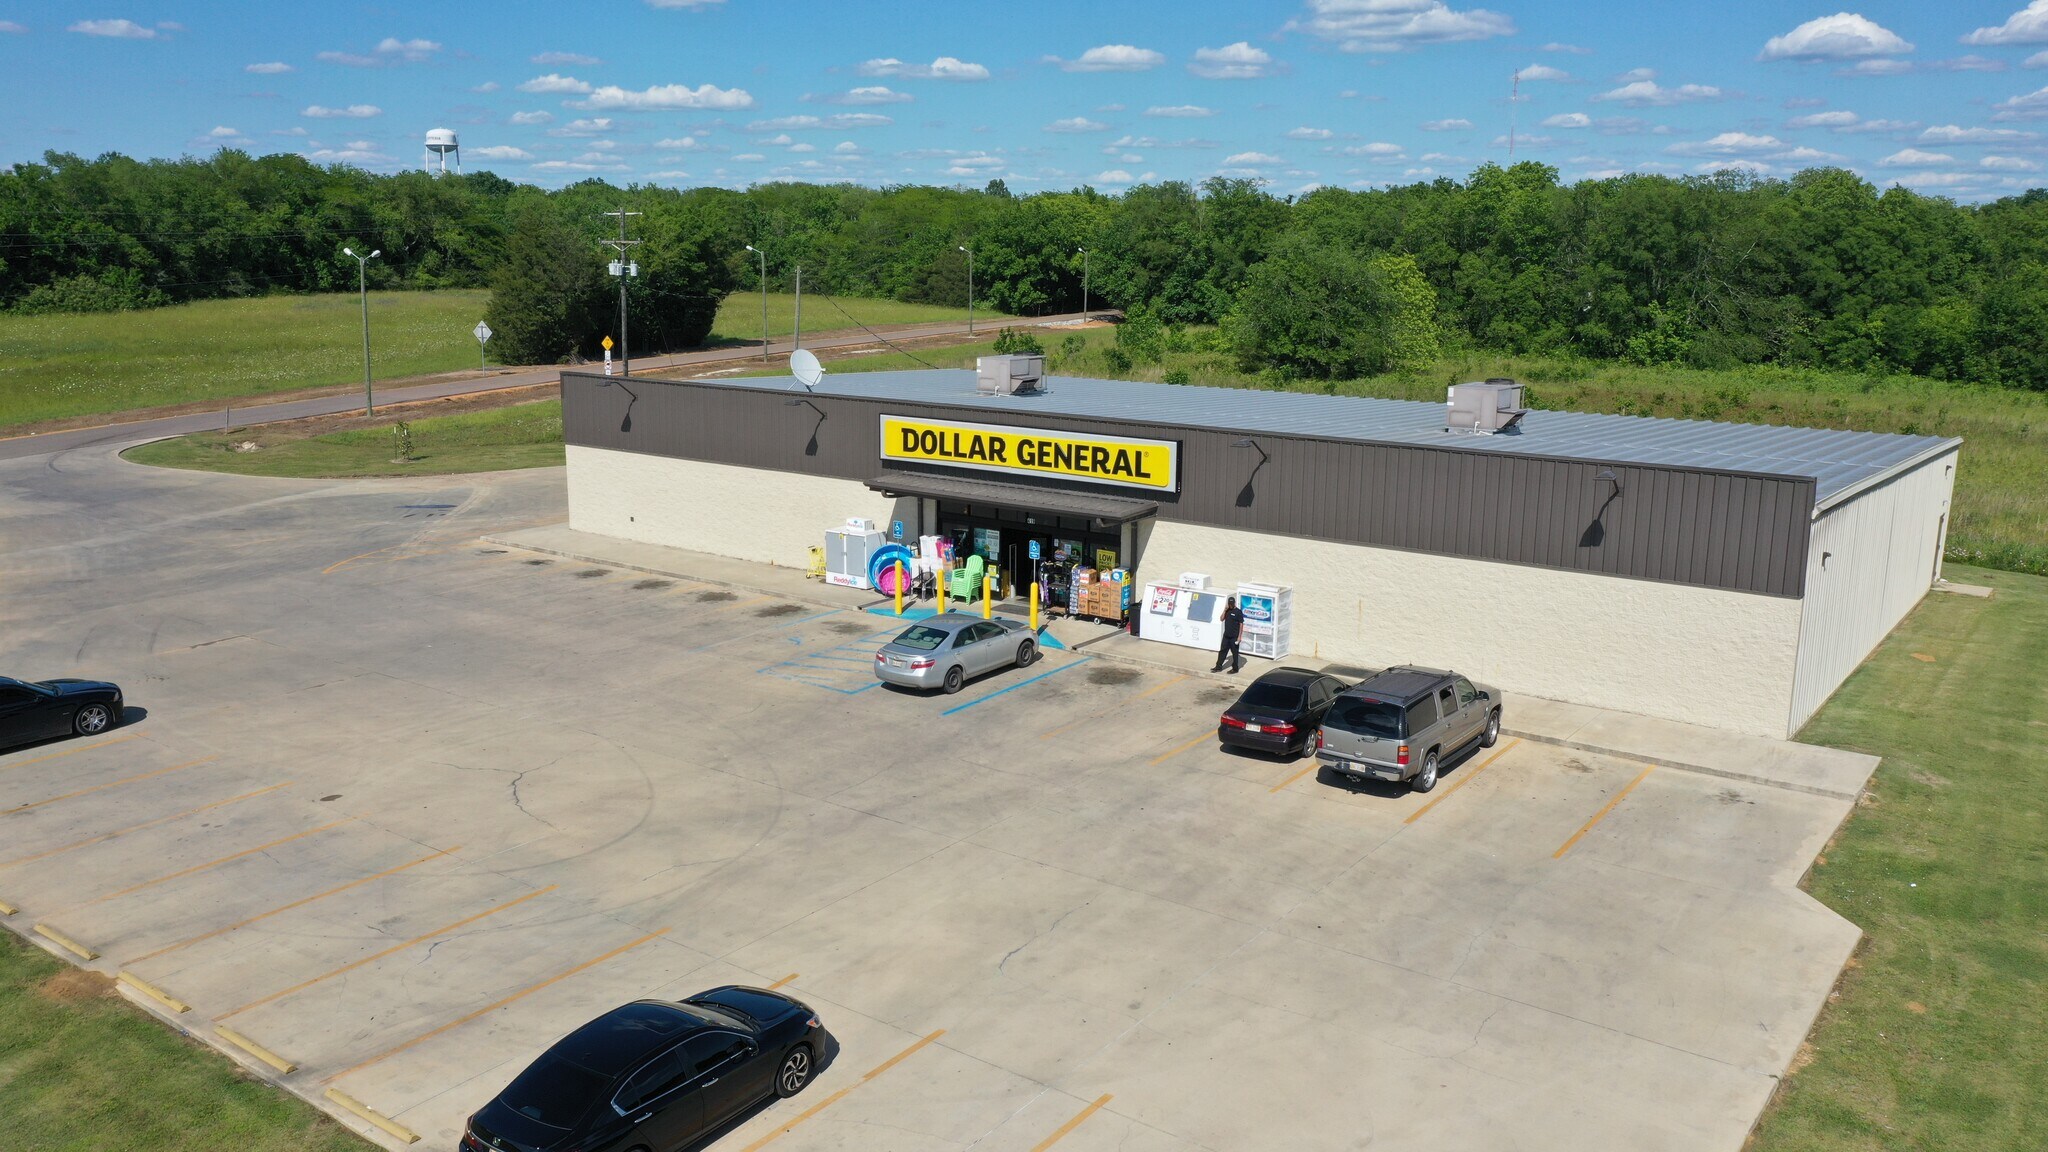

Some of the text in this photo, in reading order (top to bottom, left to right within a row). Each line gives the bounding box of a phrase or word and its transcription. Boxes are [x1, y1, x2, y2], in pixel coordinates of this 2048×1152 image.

[901, 428, 1151, 478] DOLLAR GENERAL
[1099, 554, 1113, 562] LOW
